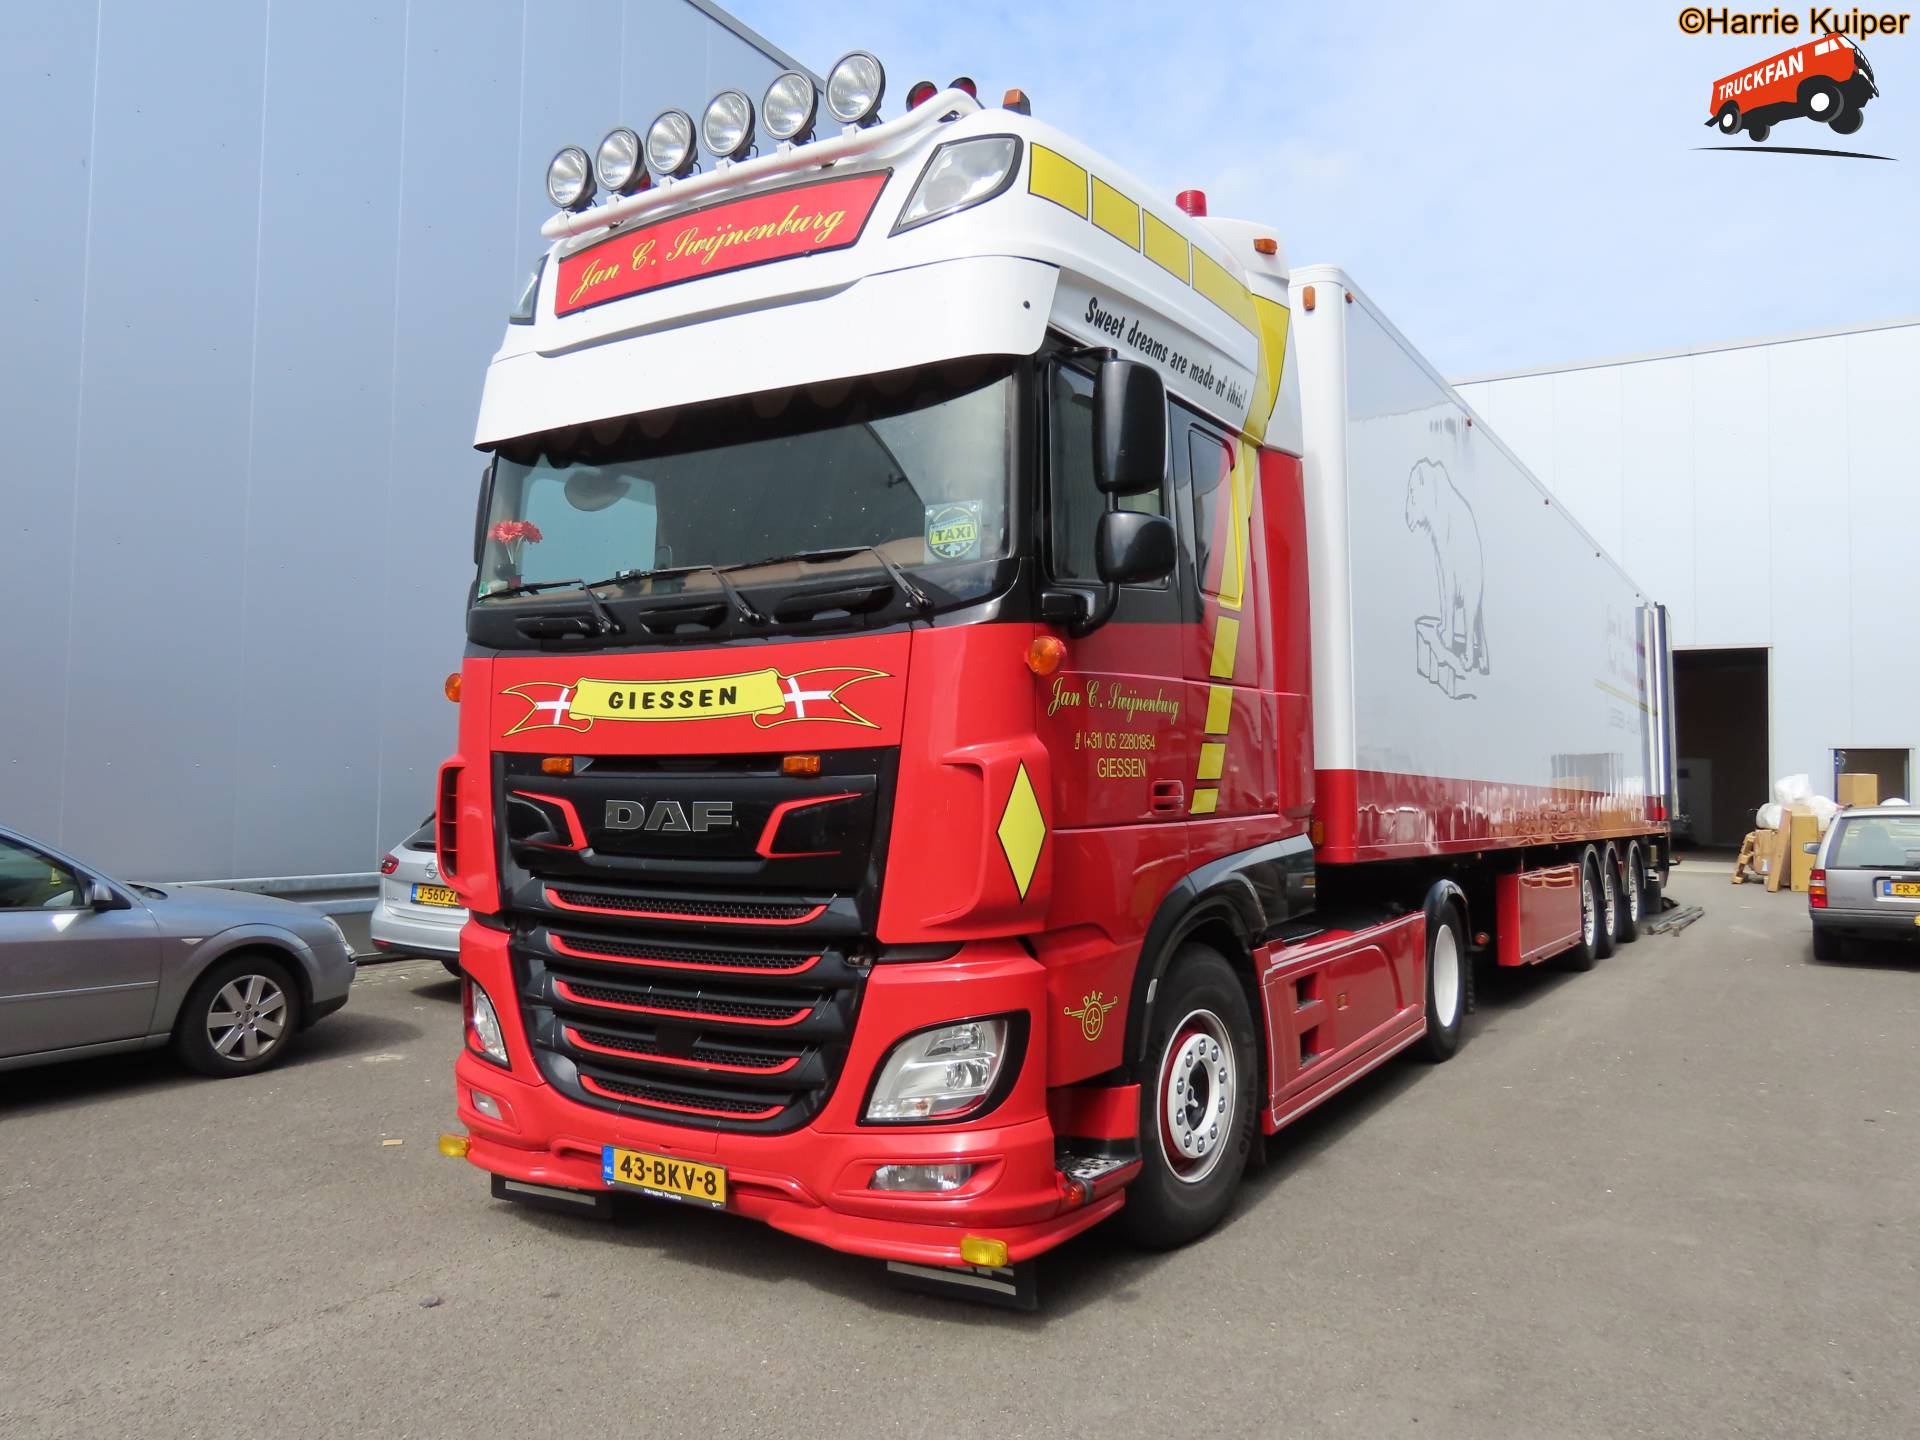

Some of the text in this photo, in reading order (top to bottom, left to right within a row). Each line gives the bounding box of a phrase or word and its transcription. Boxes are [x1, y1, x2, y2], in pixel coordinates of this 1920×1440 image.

[569, 258, 619, 304] Jan
[632, 239, 656, 271] C.
[1085, 297, 1247, 410] Sweet dreams are made of this!
[935, 526, 971, 542] TAXI
[608, 686, 737, 710] GIESSEN
[1048, 677, 1080, 717] Jan
[1084, 731, 1102, 749] (+31)
[1105, 733, 1116, 749] 06
[1097, 757, 1146, 778] GIESSEN
[604, 799, 733, 832] DAF
[1083, 990, 1103, 1007] DAF
[620, 1155, 717, 1196] 43-BKV-8
